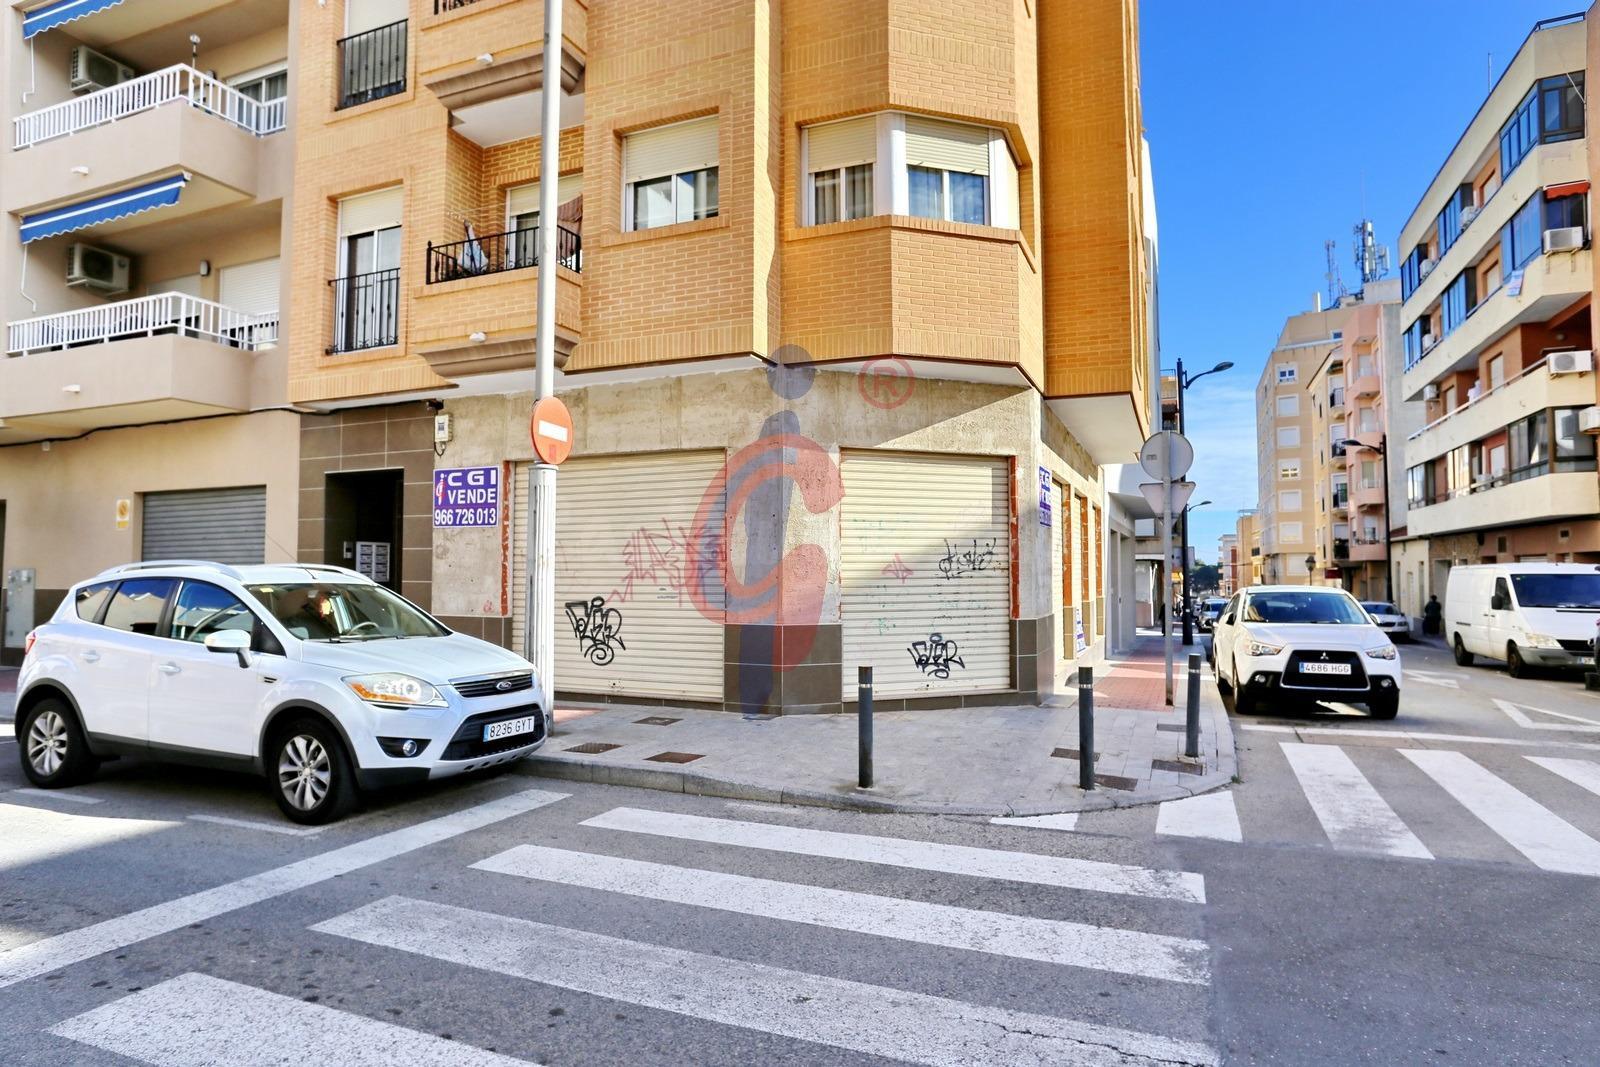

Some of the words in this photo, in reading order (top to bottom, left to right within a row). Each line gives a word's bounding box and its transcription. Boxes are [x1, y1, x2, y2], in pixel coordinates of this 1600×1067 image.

[447, 470, 496, 486] CGI
[447, 488, 497, 504] VENDE
[434, 509, 454, 525] 966
[455, 508, 475, 524] 726
[476, 508, 496, 524] 013
[1305, 664, 1328, 672] 4686
[490, 722, 512, 737] 8236
[515, 718, 532, 732] GYT
